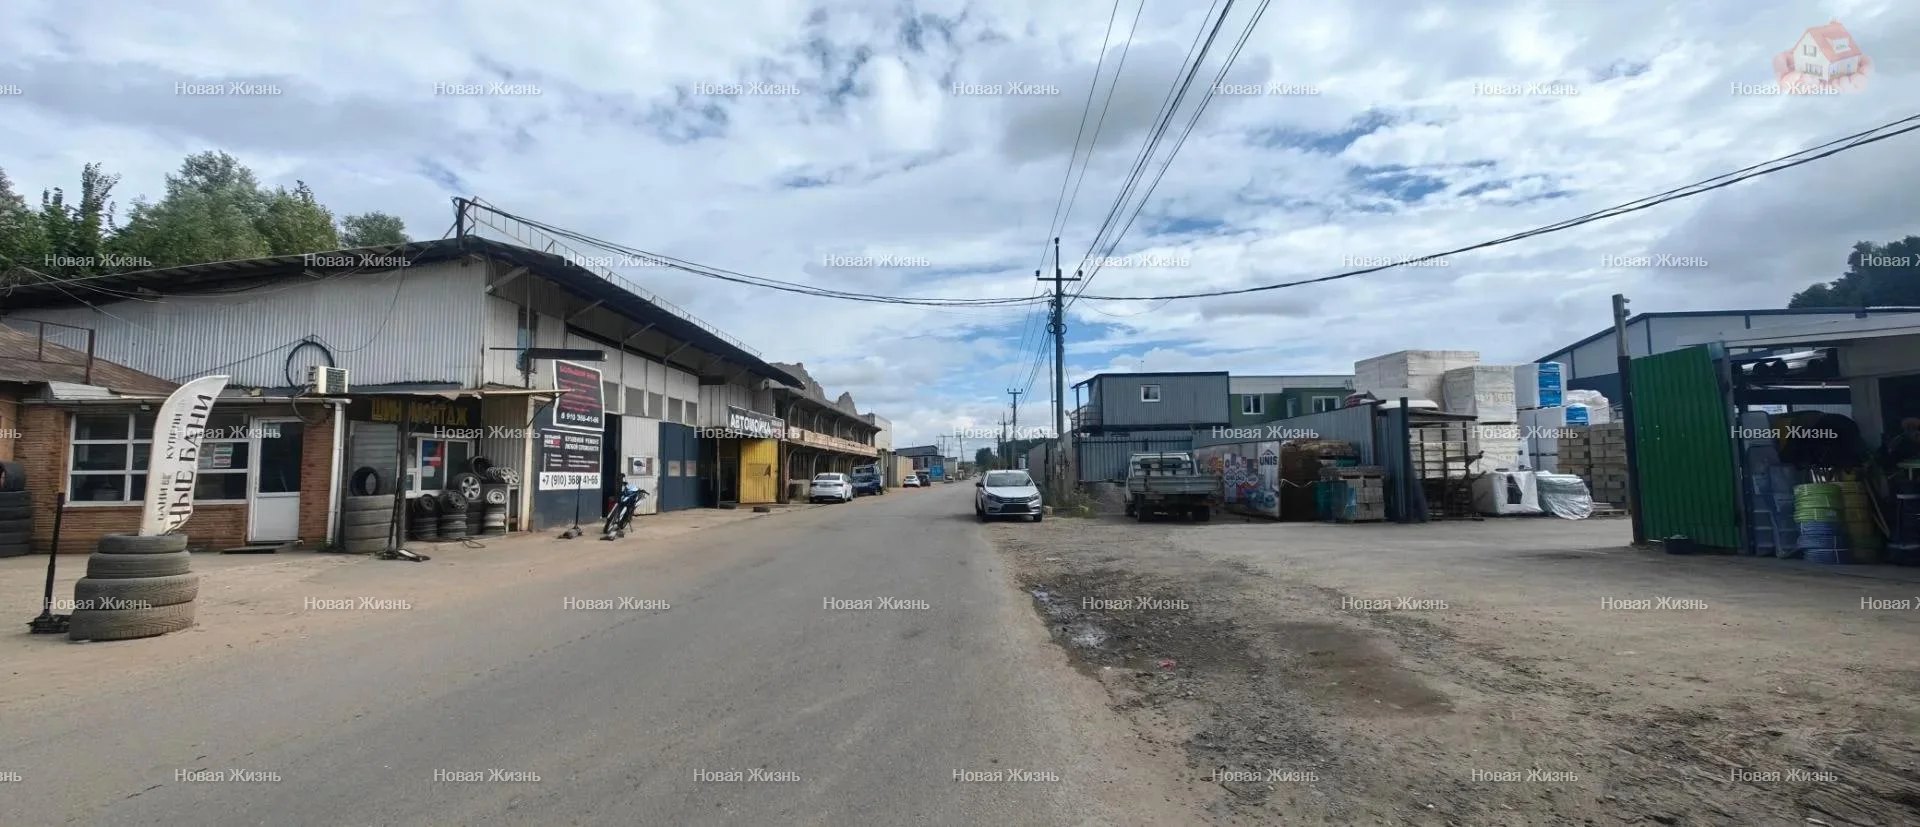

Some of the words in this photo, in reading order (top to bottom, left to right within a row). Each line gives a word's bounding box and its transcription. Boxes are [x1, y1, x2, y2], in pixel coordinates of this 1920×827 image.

[179, 394, 212, 462] БАНИ
[731, 413, 771, 434] АВТОМОЙКА
[1259, 455, 1278, 466] UNIS
[551, 475, 567, 487] (910)
